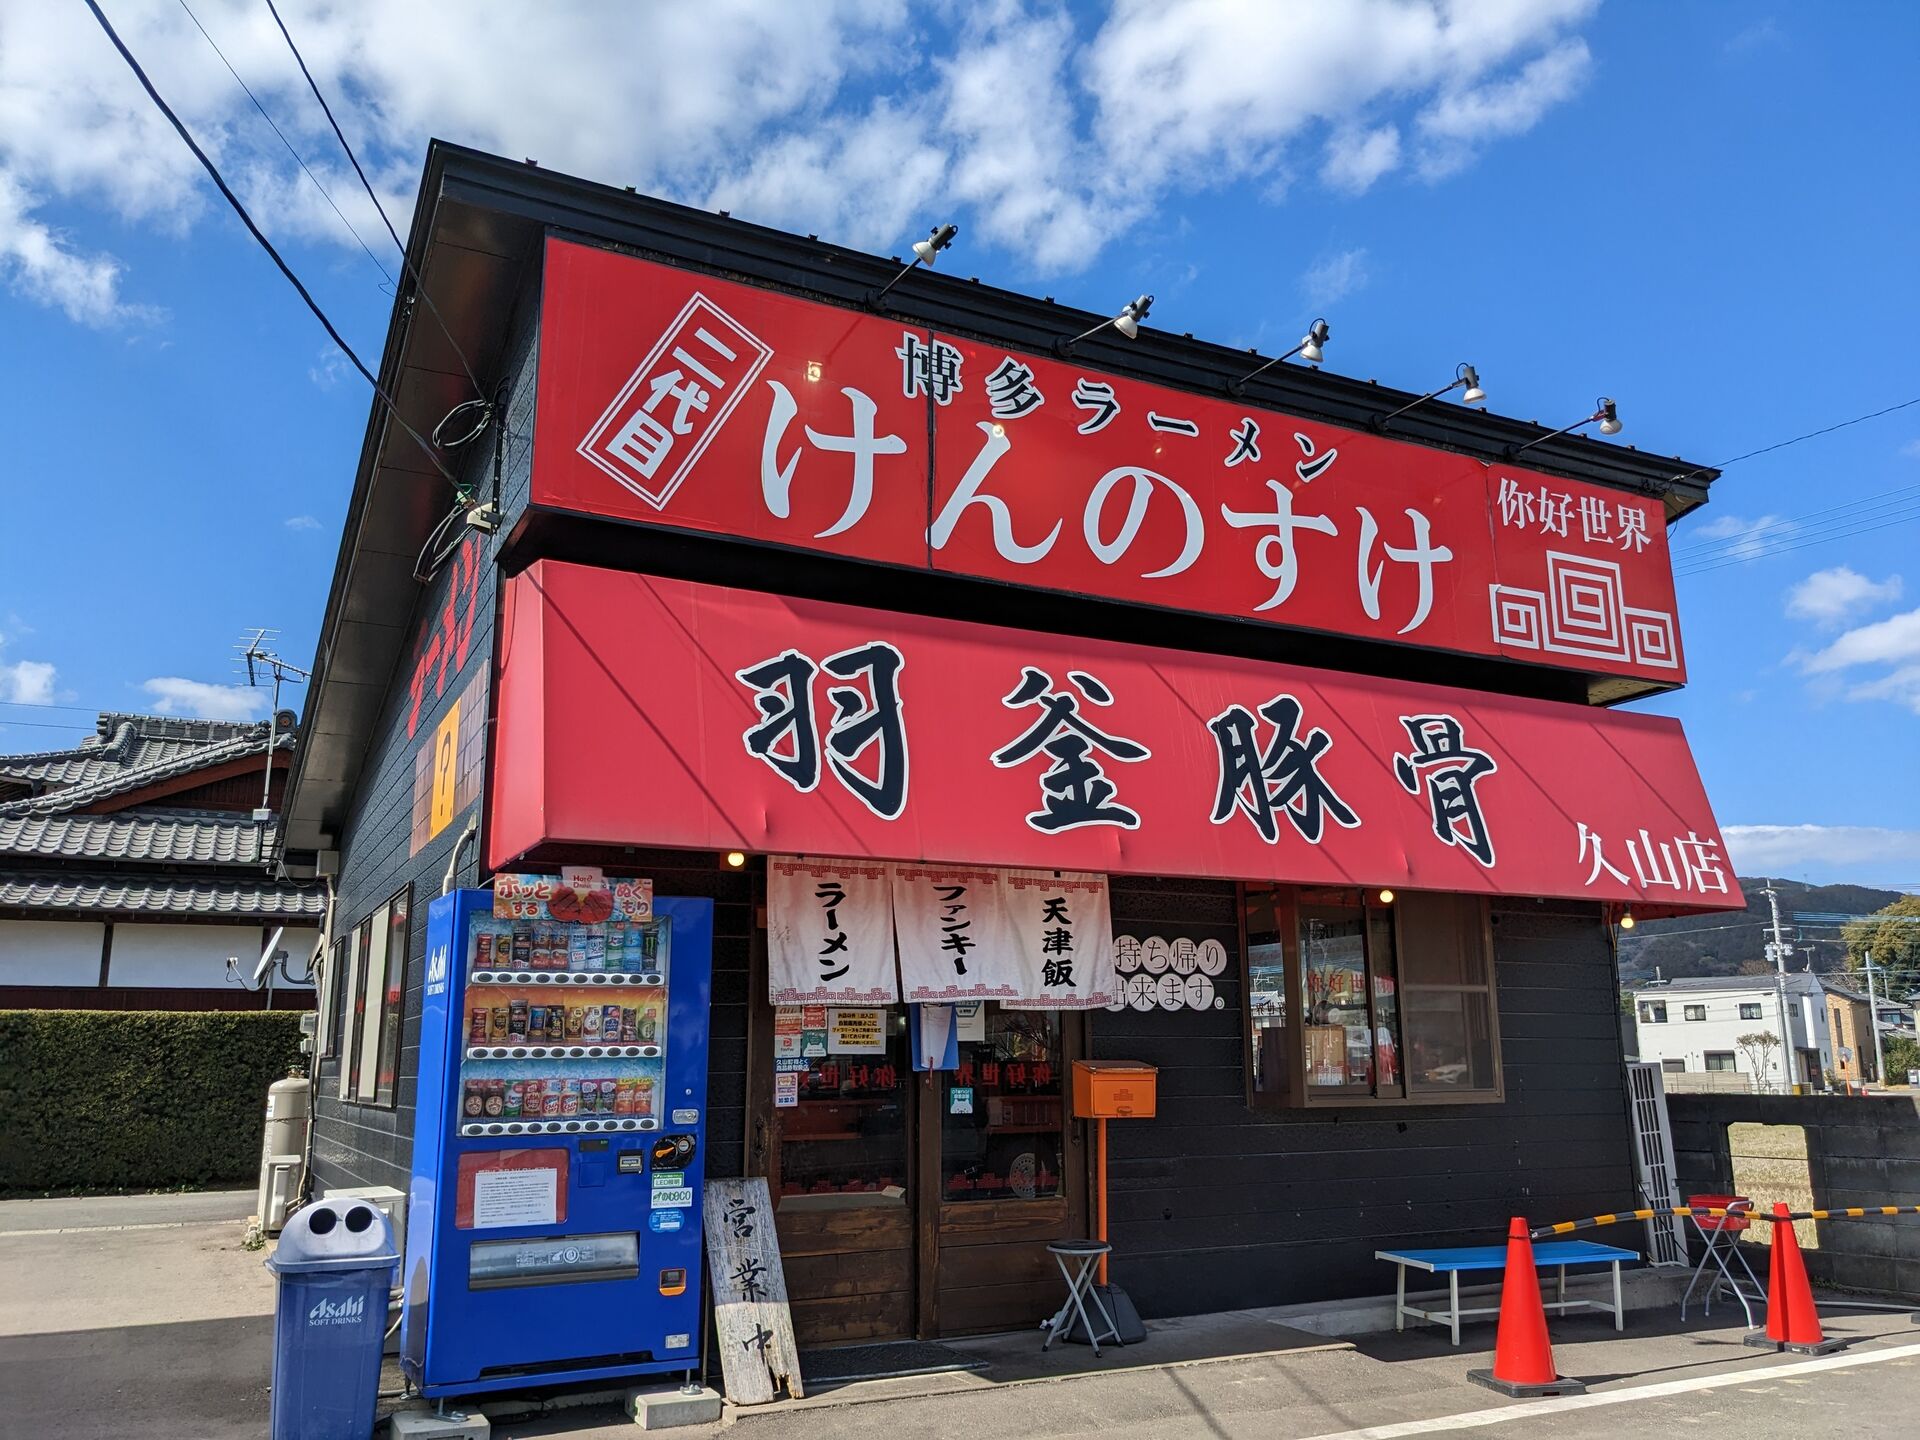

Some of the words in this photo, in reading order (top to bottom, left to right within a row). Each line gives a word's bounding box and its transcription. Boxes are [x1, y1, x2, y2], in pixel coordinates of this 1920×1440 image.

[605, 327, 738, 480] 二代目
[895, 330, 1338, 483] 博多ラーメン
[760, 379, 1454, 635] けんのすけ
[1497, 477, 1652, 553] 你好世界
[734, 640, 1498, 869] 羽釜豚骨
[499, 876, 550, 899] ホッと
[616, 883, 642, 900] ぬく
[1577, 821, 1729, 894] 久山店
[512, 901, 539, 916] する
[622, 901, 649, 916] もり
[813, 881, 851, 982] ラーメン
[932, 885, 976, 976] ファンキー
[1041, 896, 1077, 988] 天津飯
[1114, 937, 1220, 970] 持ち帰り
[309, 1295, 364, 1319] Asahi
[723, 1198, 775, 1352] 営業中
[309, 1318, 331, 1327] SOFT
[332, 1315, 362, 1325] DRINKS
